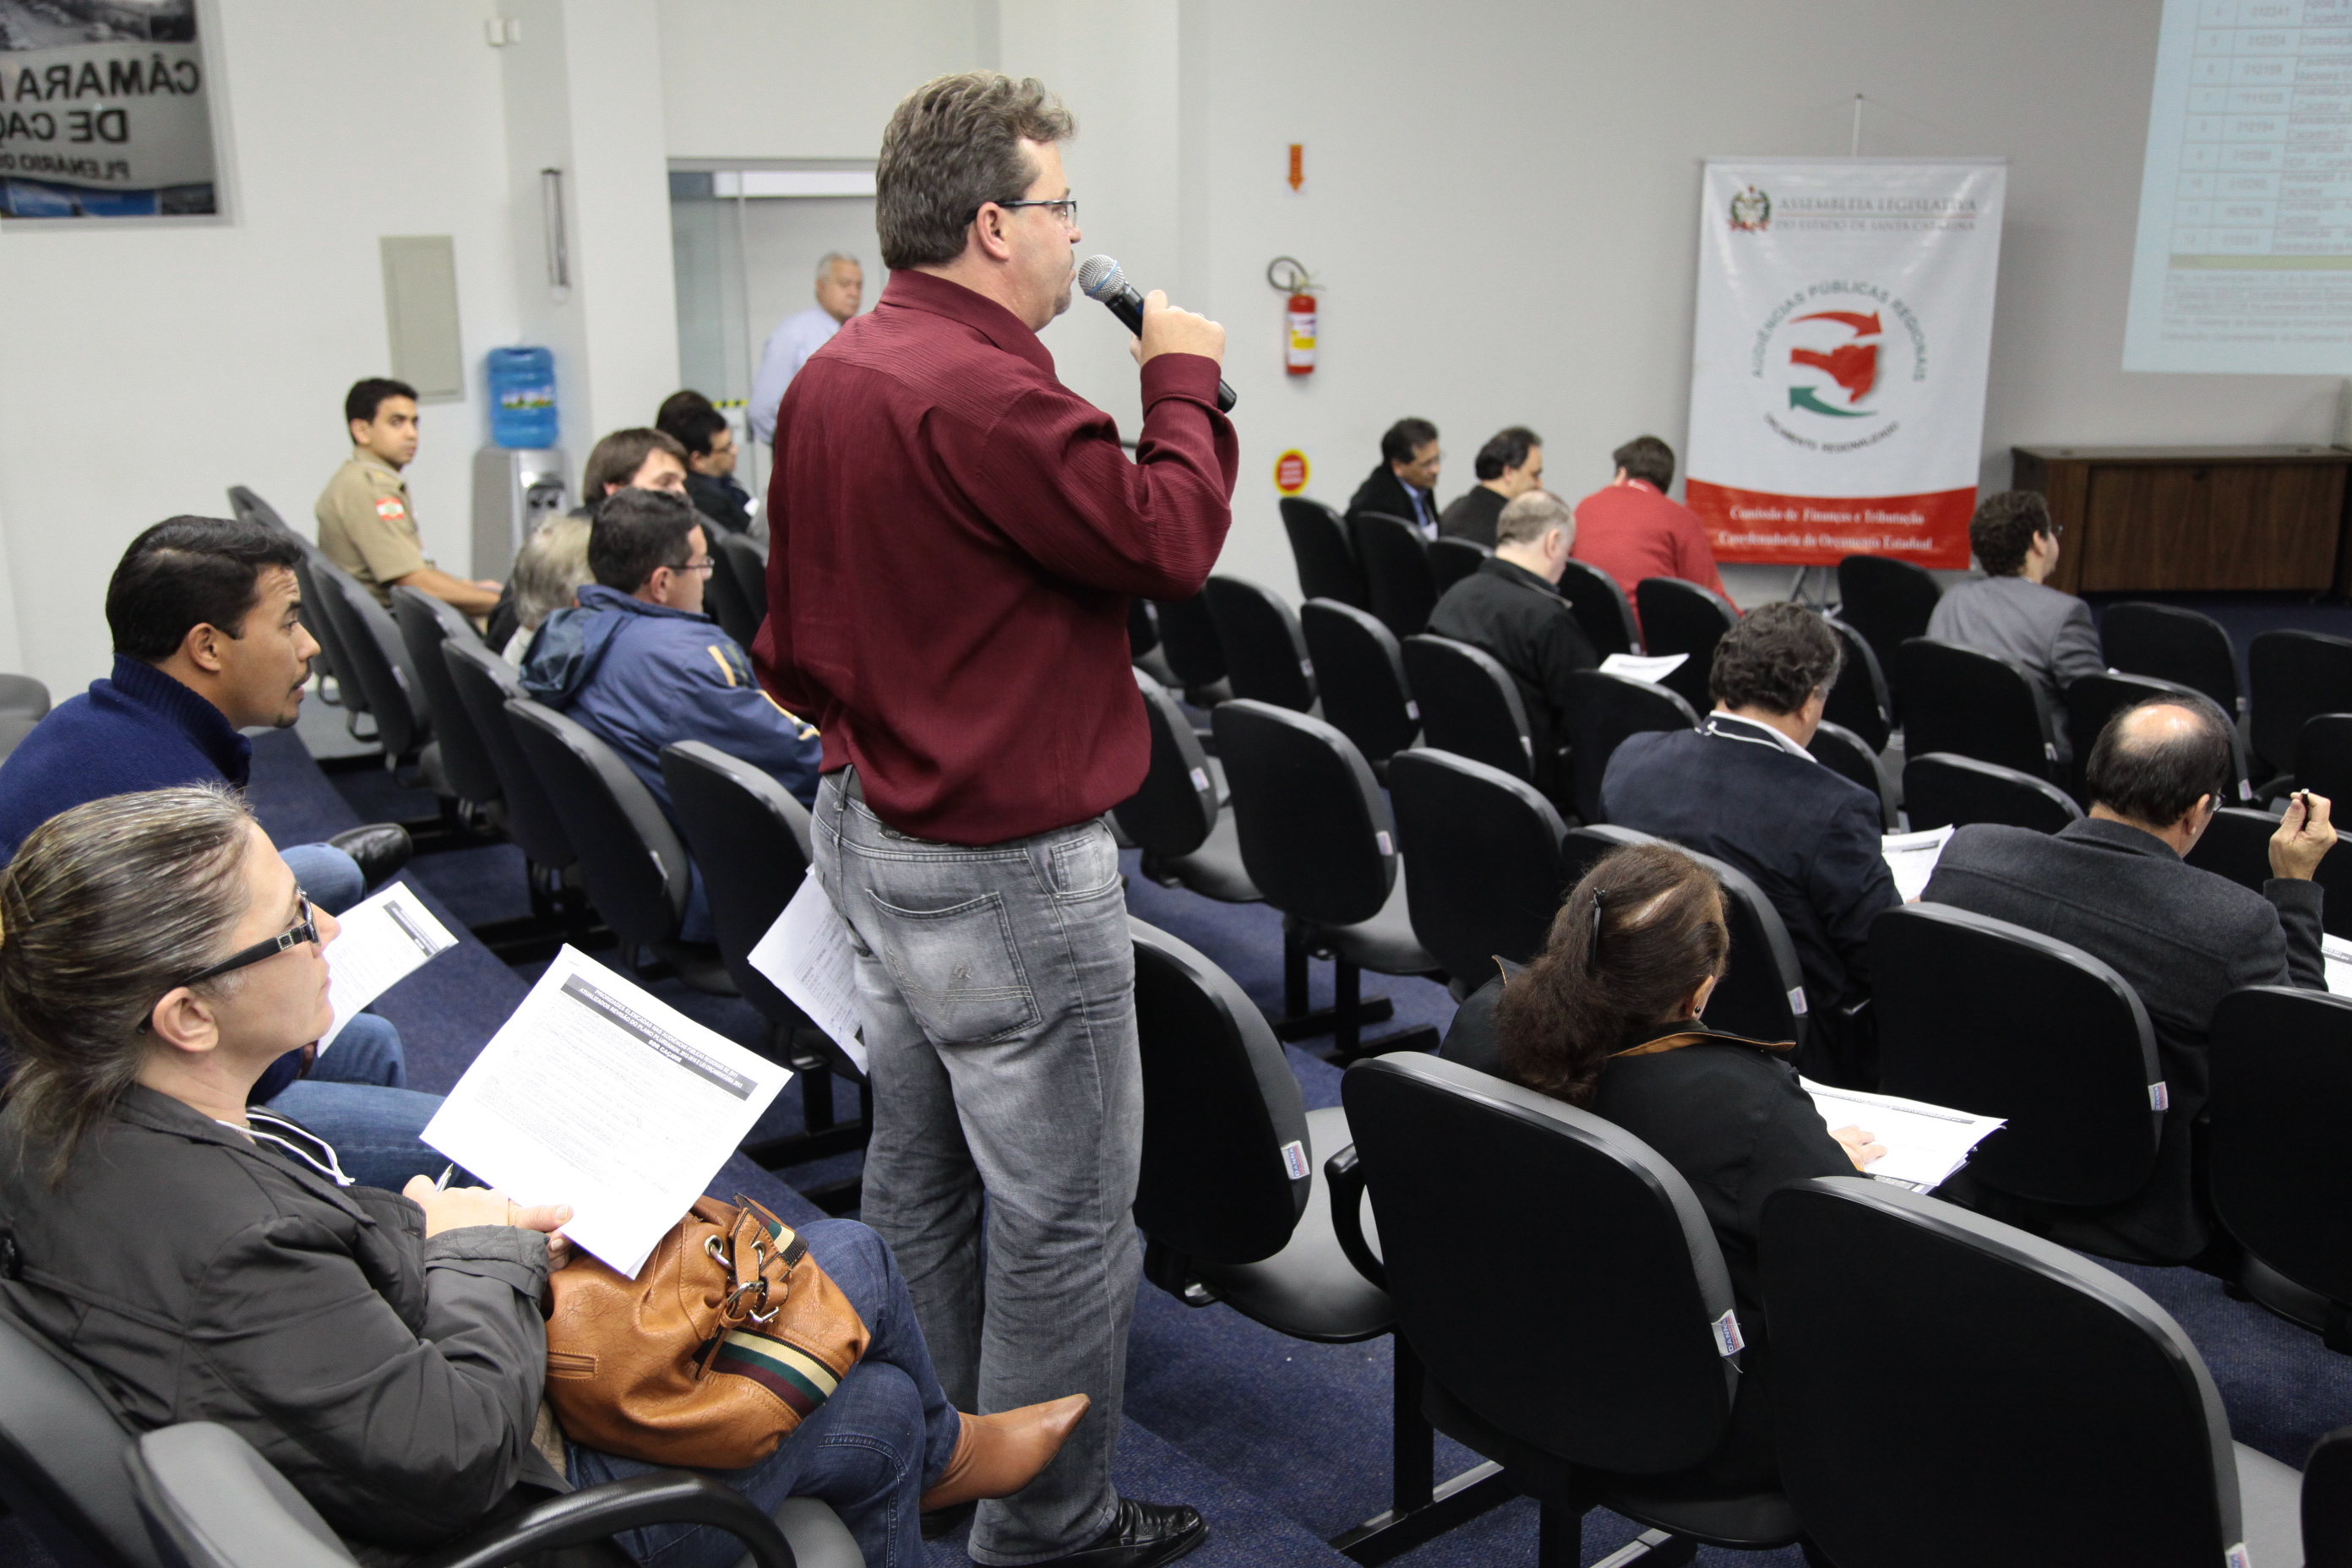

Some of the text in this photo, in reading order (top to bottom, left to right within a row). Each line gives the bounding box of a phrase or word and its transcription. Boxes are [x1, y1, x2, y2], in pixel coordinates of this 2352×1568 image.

[579, 987, 611, 1009] ATUALIZADOS
[609, 1005, 631, 1021] REVISÃO
[629, 1018, 638, 1026] DO
[637, 1023, 654, 1037] PLANO
[594, 988, 625, 1010] PRIORIDADES
[624, 1008, 652, 1027] ELENCADAS
[651, 1025, 662, 1034] NAS
[648, 1039, 682, 1064] SDR CAÇADOR
[1288, 1147, 1300, 1177] DANNA
